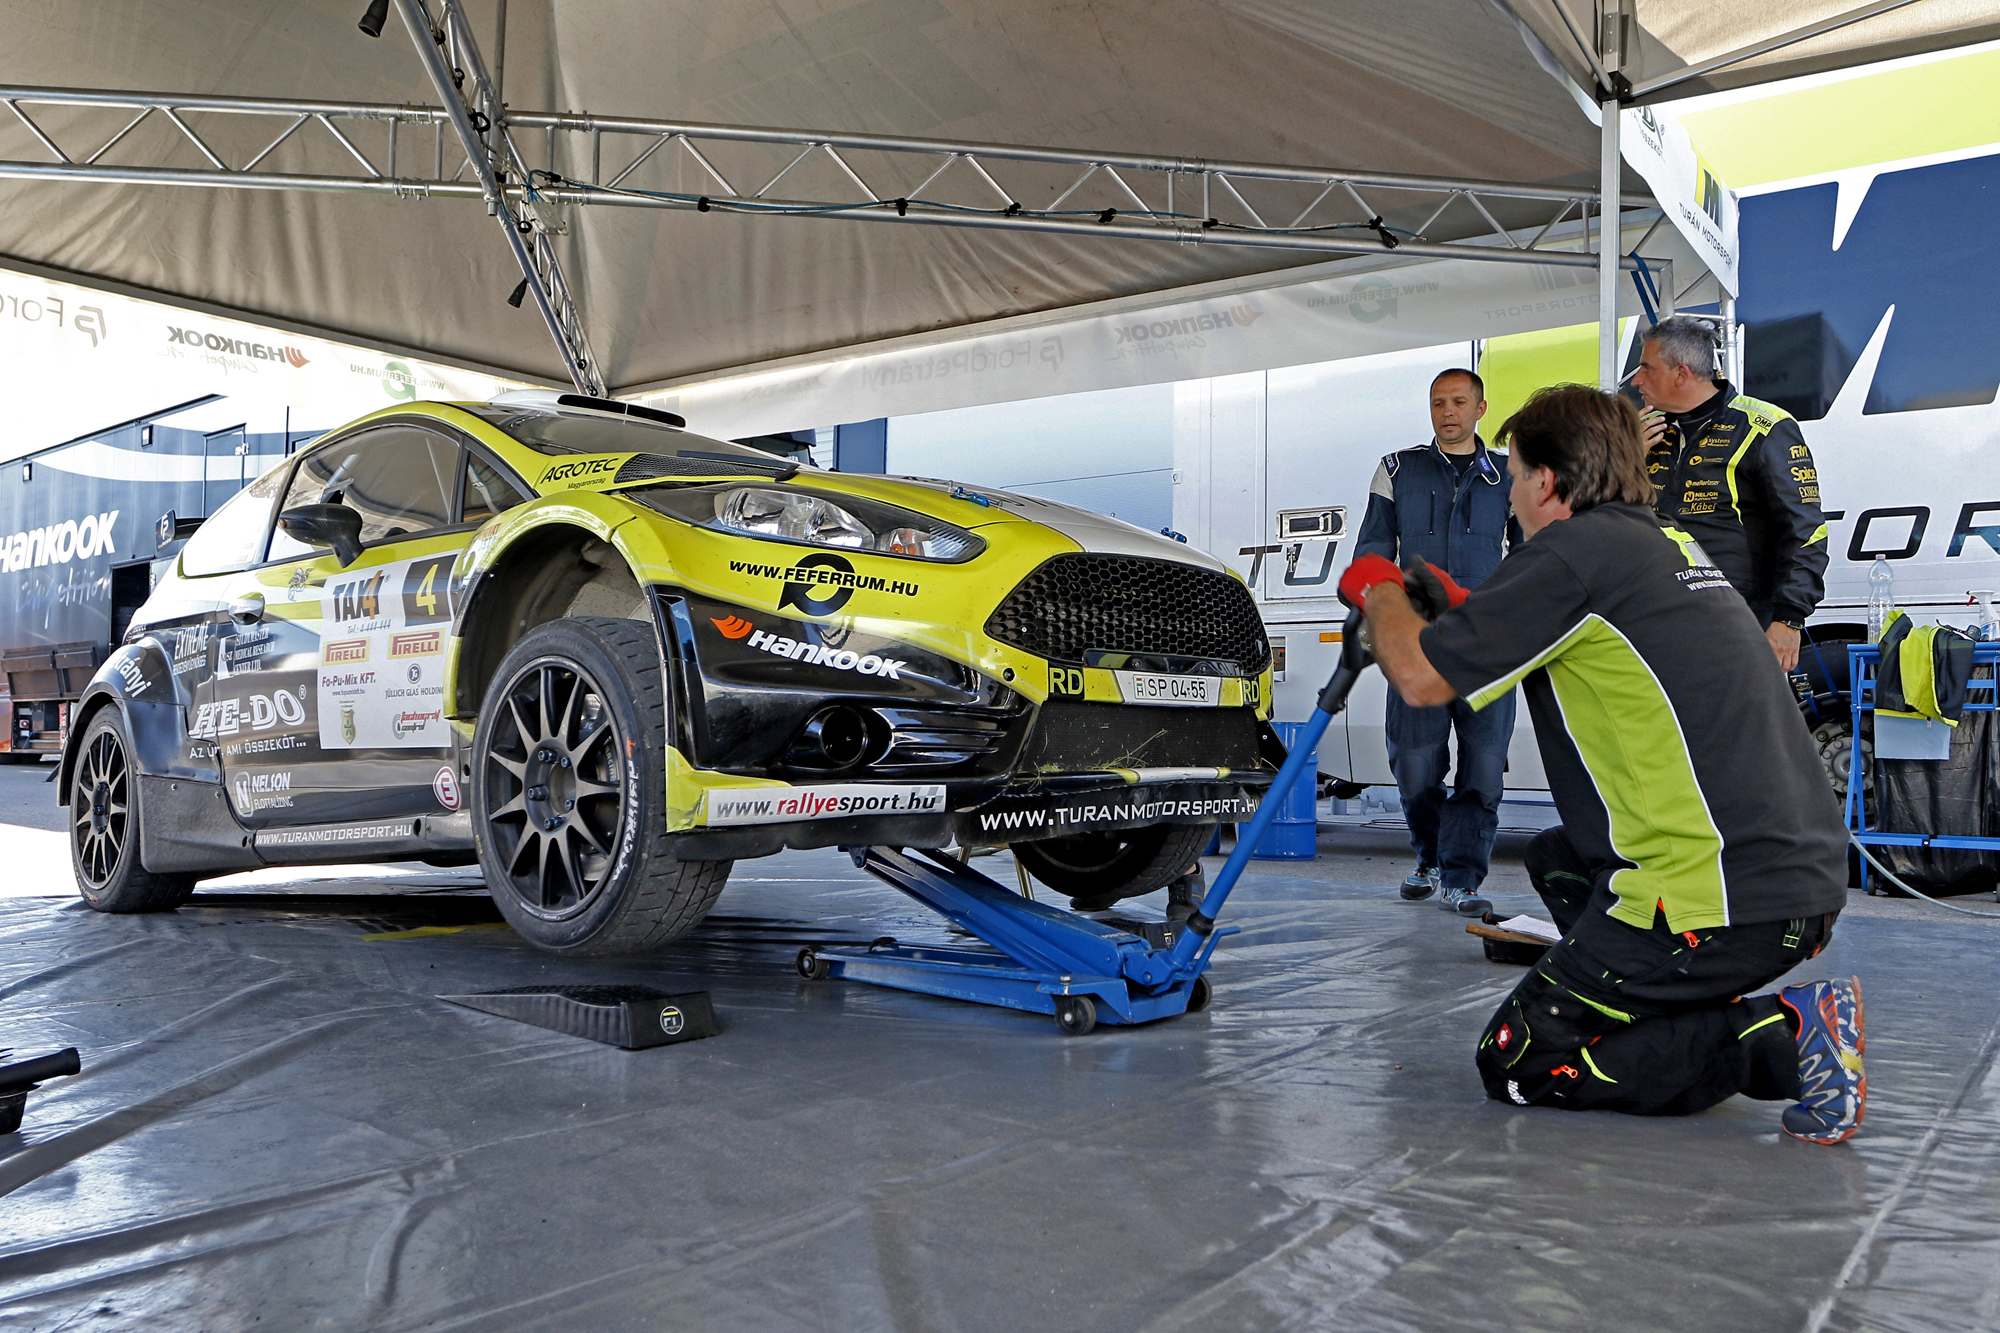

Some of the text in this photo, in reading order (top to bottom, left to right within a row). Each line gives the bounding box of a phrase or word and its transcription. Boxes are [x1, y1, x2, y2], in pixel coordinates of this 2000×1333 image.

[1679, 201, 1733, 268] TURÁN MOTORSPORT
[1754, 416, 1772, 429] OMP
[540, 458, 619, 485] AGROTEC
[1790, 466, 1817, 484] Spice
[1690, 502, 1717, 512] Kábel
[416, 563, 439, 616] 4
[729, 560, 919, 597] WWW.FEFERRUM.HU
[173, 620, 211, 661] EXTREME
[325, 640, 366, 662] PIRELLI
[391, 631, 440, 656] PIRELLI
[360, 672, 376, 684] KFT.
[1050, 667, 1084, 695] RD
[1148, 680, 1168, 698] SP
[1171, 681, 1207, 700] 04-55
[1244, 680, 1260, 702] RD
[189, 747, 205, 759] AZ
[226, 744, 242, 756] AMI
[252, 771, 292, 793] NELSON
[716, 792, 938, 818] www.rallyesport.hu
[255, 824, 413, 846] WWW.TURANMOTORSPORT.HU
